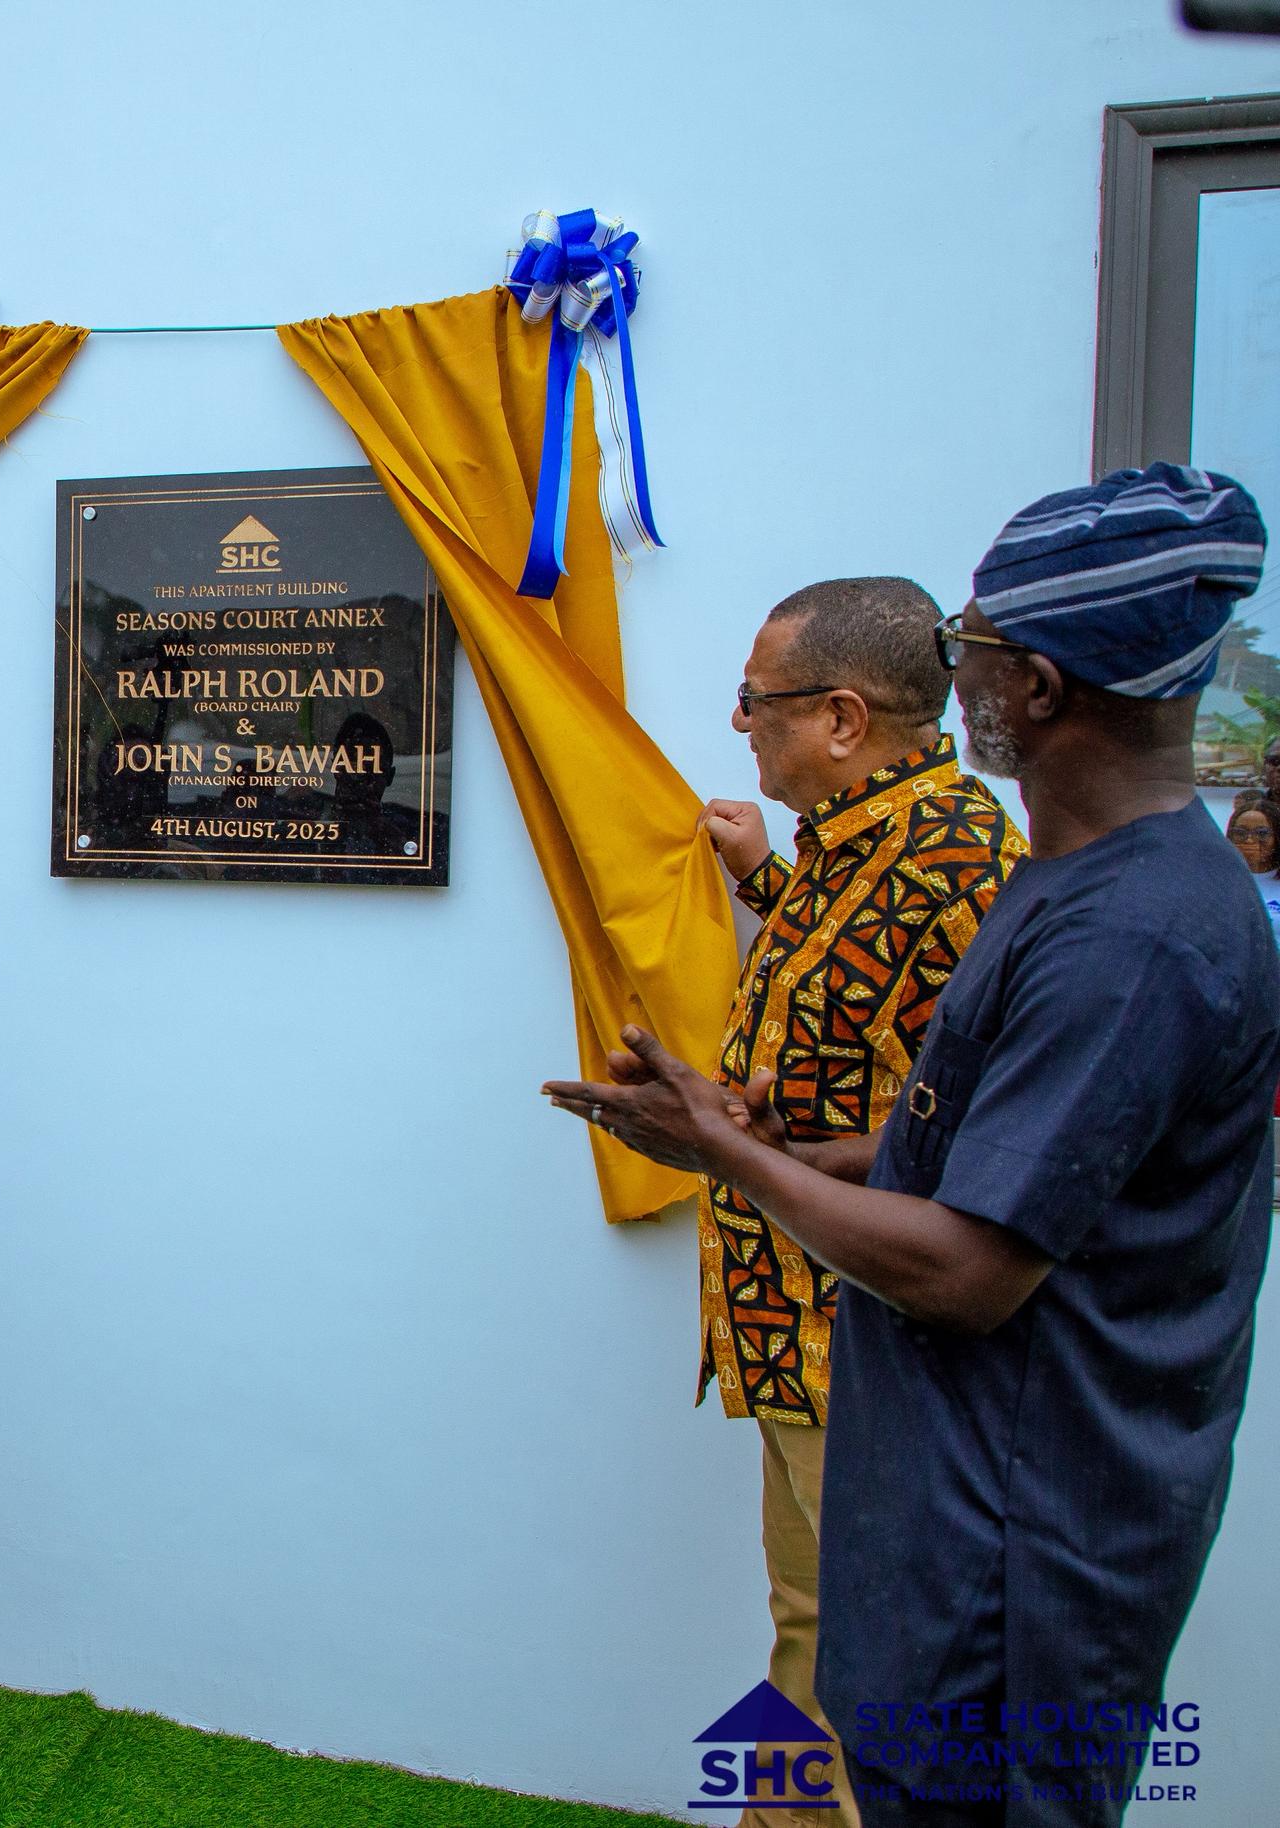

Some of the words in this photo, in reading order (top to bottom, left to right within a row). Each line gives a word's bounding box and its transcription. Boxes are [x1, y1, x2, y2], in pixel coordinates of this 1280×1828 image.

[221, 545, 280, 568] SHC
[154, 586, 186, 598] THIS
[189, 584, 273, 598] APARTMENT
[278, 582, 348, 596] BUILDING
[116, 611, 216, 631] SEASONS
[223, 609, 298, 630] COURT
[305, 608, 385, 628] ANNEX
[163, 644, 195, 657] WAS
[198, 643, 312, 657] COMMISSIONED
[316, 641, 336, 655] BY
[117, 670, 227, 699] RALPH
[239, 668, 384, 698] ROLAND
[194, 701, 248, 713] (BOARD
[252, 701, 300, 713] CHAIR)
[236, 718, 256, 735] &
[114, 744, 203, 775] JOHN
[214, 745, 242, 774] S.
[255, 745, 383, 774] BAWAH
[168, 775, 246, 787] (MANAGING
[249, 776, 324, 788] DIRECTOR)
[236, 796, 258, 808] ON
[150, 818, 190, 837] 4TH
[195, 820, 280, 841] AUGUST,
[287, 822, 339, 840] 2025
